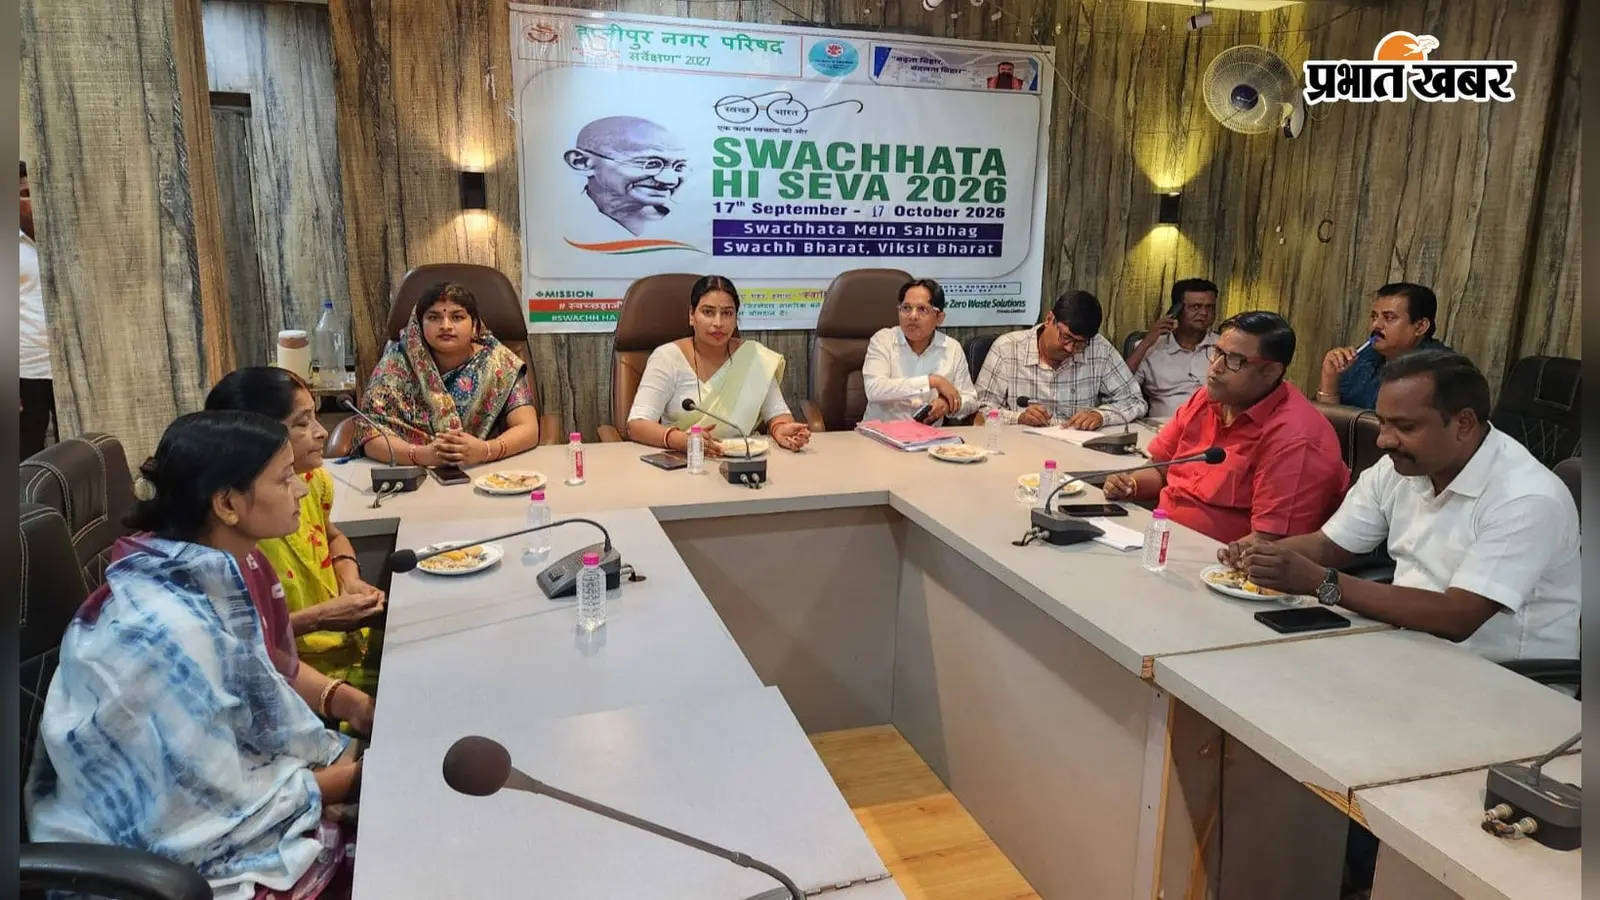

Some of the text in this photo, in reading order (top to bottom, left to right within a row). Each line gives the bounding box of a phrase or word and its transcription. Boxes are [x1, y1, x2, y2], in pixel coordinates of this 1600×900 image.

[662, 33, 710, 49] नगर
[720, 34, 785, 55] परिषद
[774, 108, 799, 117] भारत
[712, 137, 1007, 177] SWACHHATA
[712, 169, 1007, 204] HI SEVA 2026
[713, 200, 745, 213] 17th
[752, 202, 847, 217] September
[894, 205, 959, 217] October
[965, 206, 1005, 218] 2026
[744, 223, 978, 238] Swachhata Mein Sahbhag
[723, 241, 994, 255] Swachh Bharat, Viksit Bharat
[544, 290, 593, 298] MISSION
[949, 299, 967, 308] Zero
[967, 299, 991, 308] Waste
[991, 298, 1026, 308] Solutions
[552, 314, 599, 322] #SWACHH
